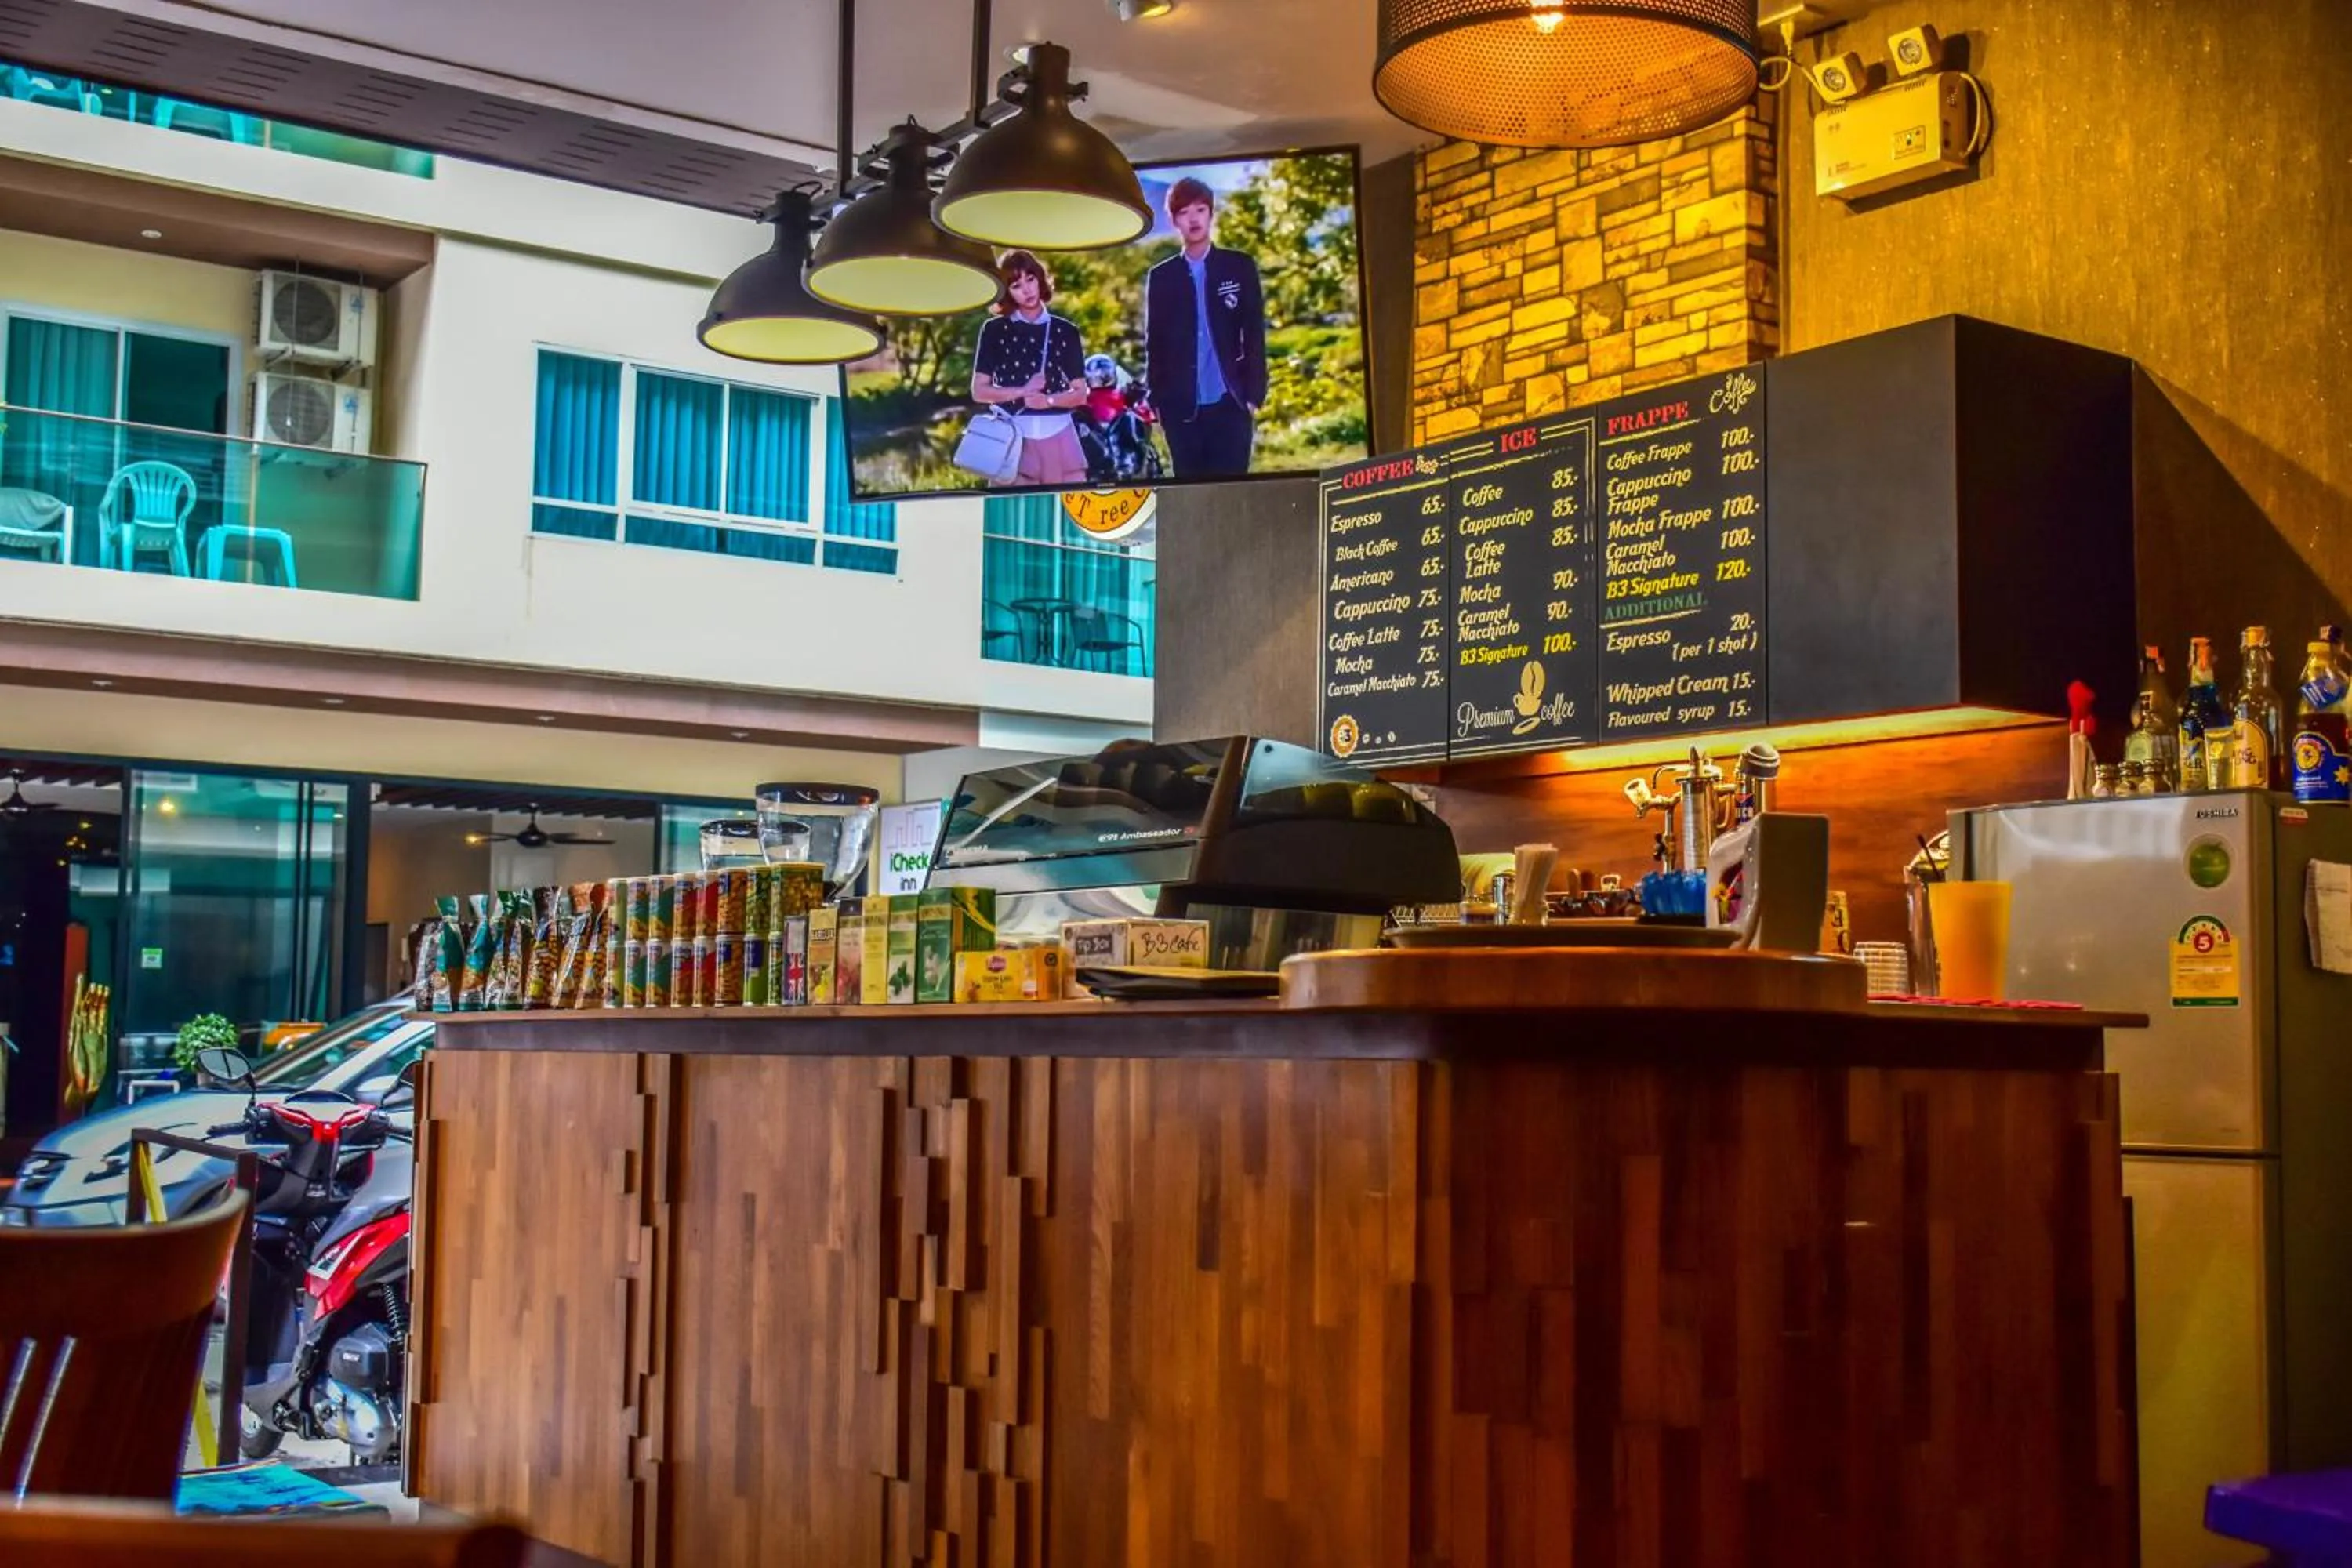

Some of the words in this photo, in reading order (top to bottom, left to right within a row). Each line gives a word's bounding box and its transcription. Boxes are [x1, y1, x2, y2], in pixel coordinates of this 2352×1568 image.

[1607, 401, 1688, 436] FRAPPE
[1501, 427, 1537, 453] ICE
[1607, 450, 1646, 470] Coffee
[1647, 441, 1693, 462] Frappe
[1342, 459, 1414, 489] COFFEE
[1607, 467, 1692, 497] Cappuccino
[1463, 484, 1504, 507] Coffee
[1607, 494, 1659, 515] Frappe
[1331, 512, 1382, 534] Espresso
[1459, 507, 1534, 536] Cappuccino
[1607, 517, 1655, 539] Mocha
[1658, 508, 1712, 530] Frappe
[1335, 543, 1364, 561] Black
[1366, 539, 1398, 557] Coffee
[1465, 539, 1505, 561] Coffee
[1606, 533, 1665, 560] Caramel
[1465, 558, 1501, 579] Latte
[1606, 551, 1676, 577] Macchiato
[1329, 570, 1394, 592] Americano
[1606, 579, 1628, 600] B3
[1629, 572, 1700, 597] Signature
[1459, 583, 1501, 604] Mocha
[1334, 593, 1410, 622] Cappuccino
[1457, 602, 1511, 626] Caramel
[1605, 592, 1707, 620] ADDITIONAL
[1329, 632, 1365, 652] Coffee
[1367, 626, 1400, 645] Latte
[1457, 619, 1520, 643] Macchiato
[1606, 630, 1671, 655] Espresso
[1460, 648, 1476, 666] B3
[1477, 644, 1529, 664] Signature
[1708, 637, 1715, 654] 1
[1335, 655, 1374, 675] Mocha
[1327, 678, 1367, 696] Caramel
[1368, 673, 1417, 692] Macchiato
[1606, 677, 1675, 704] Whipped
[1677, 674, 1729, 695] Cream
[1457, 702, 1515, 737] Premium
[1541, 692, 1575, 726] coffee
[1608, 706, 1671, 728] Flavoured
[1677, 705, 1715, 723] syrup
[890, 852, 929, 872] iCheck
[900, 877, 916, 891] inn
[2198, 935, 2210, 950] 5
